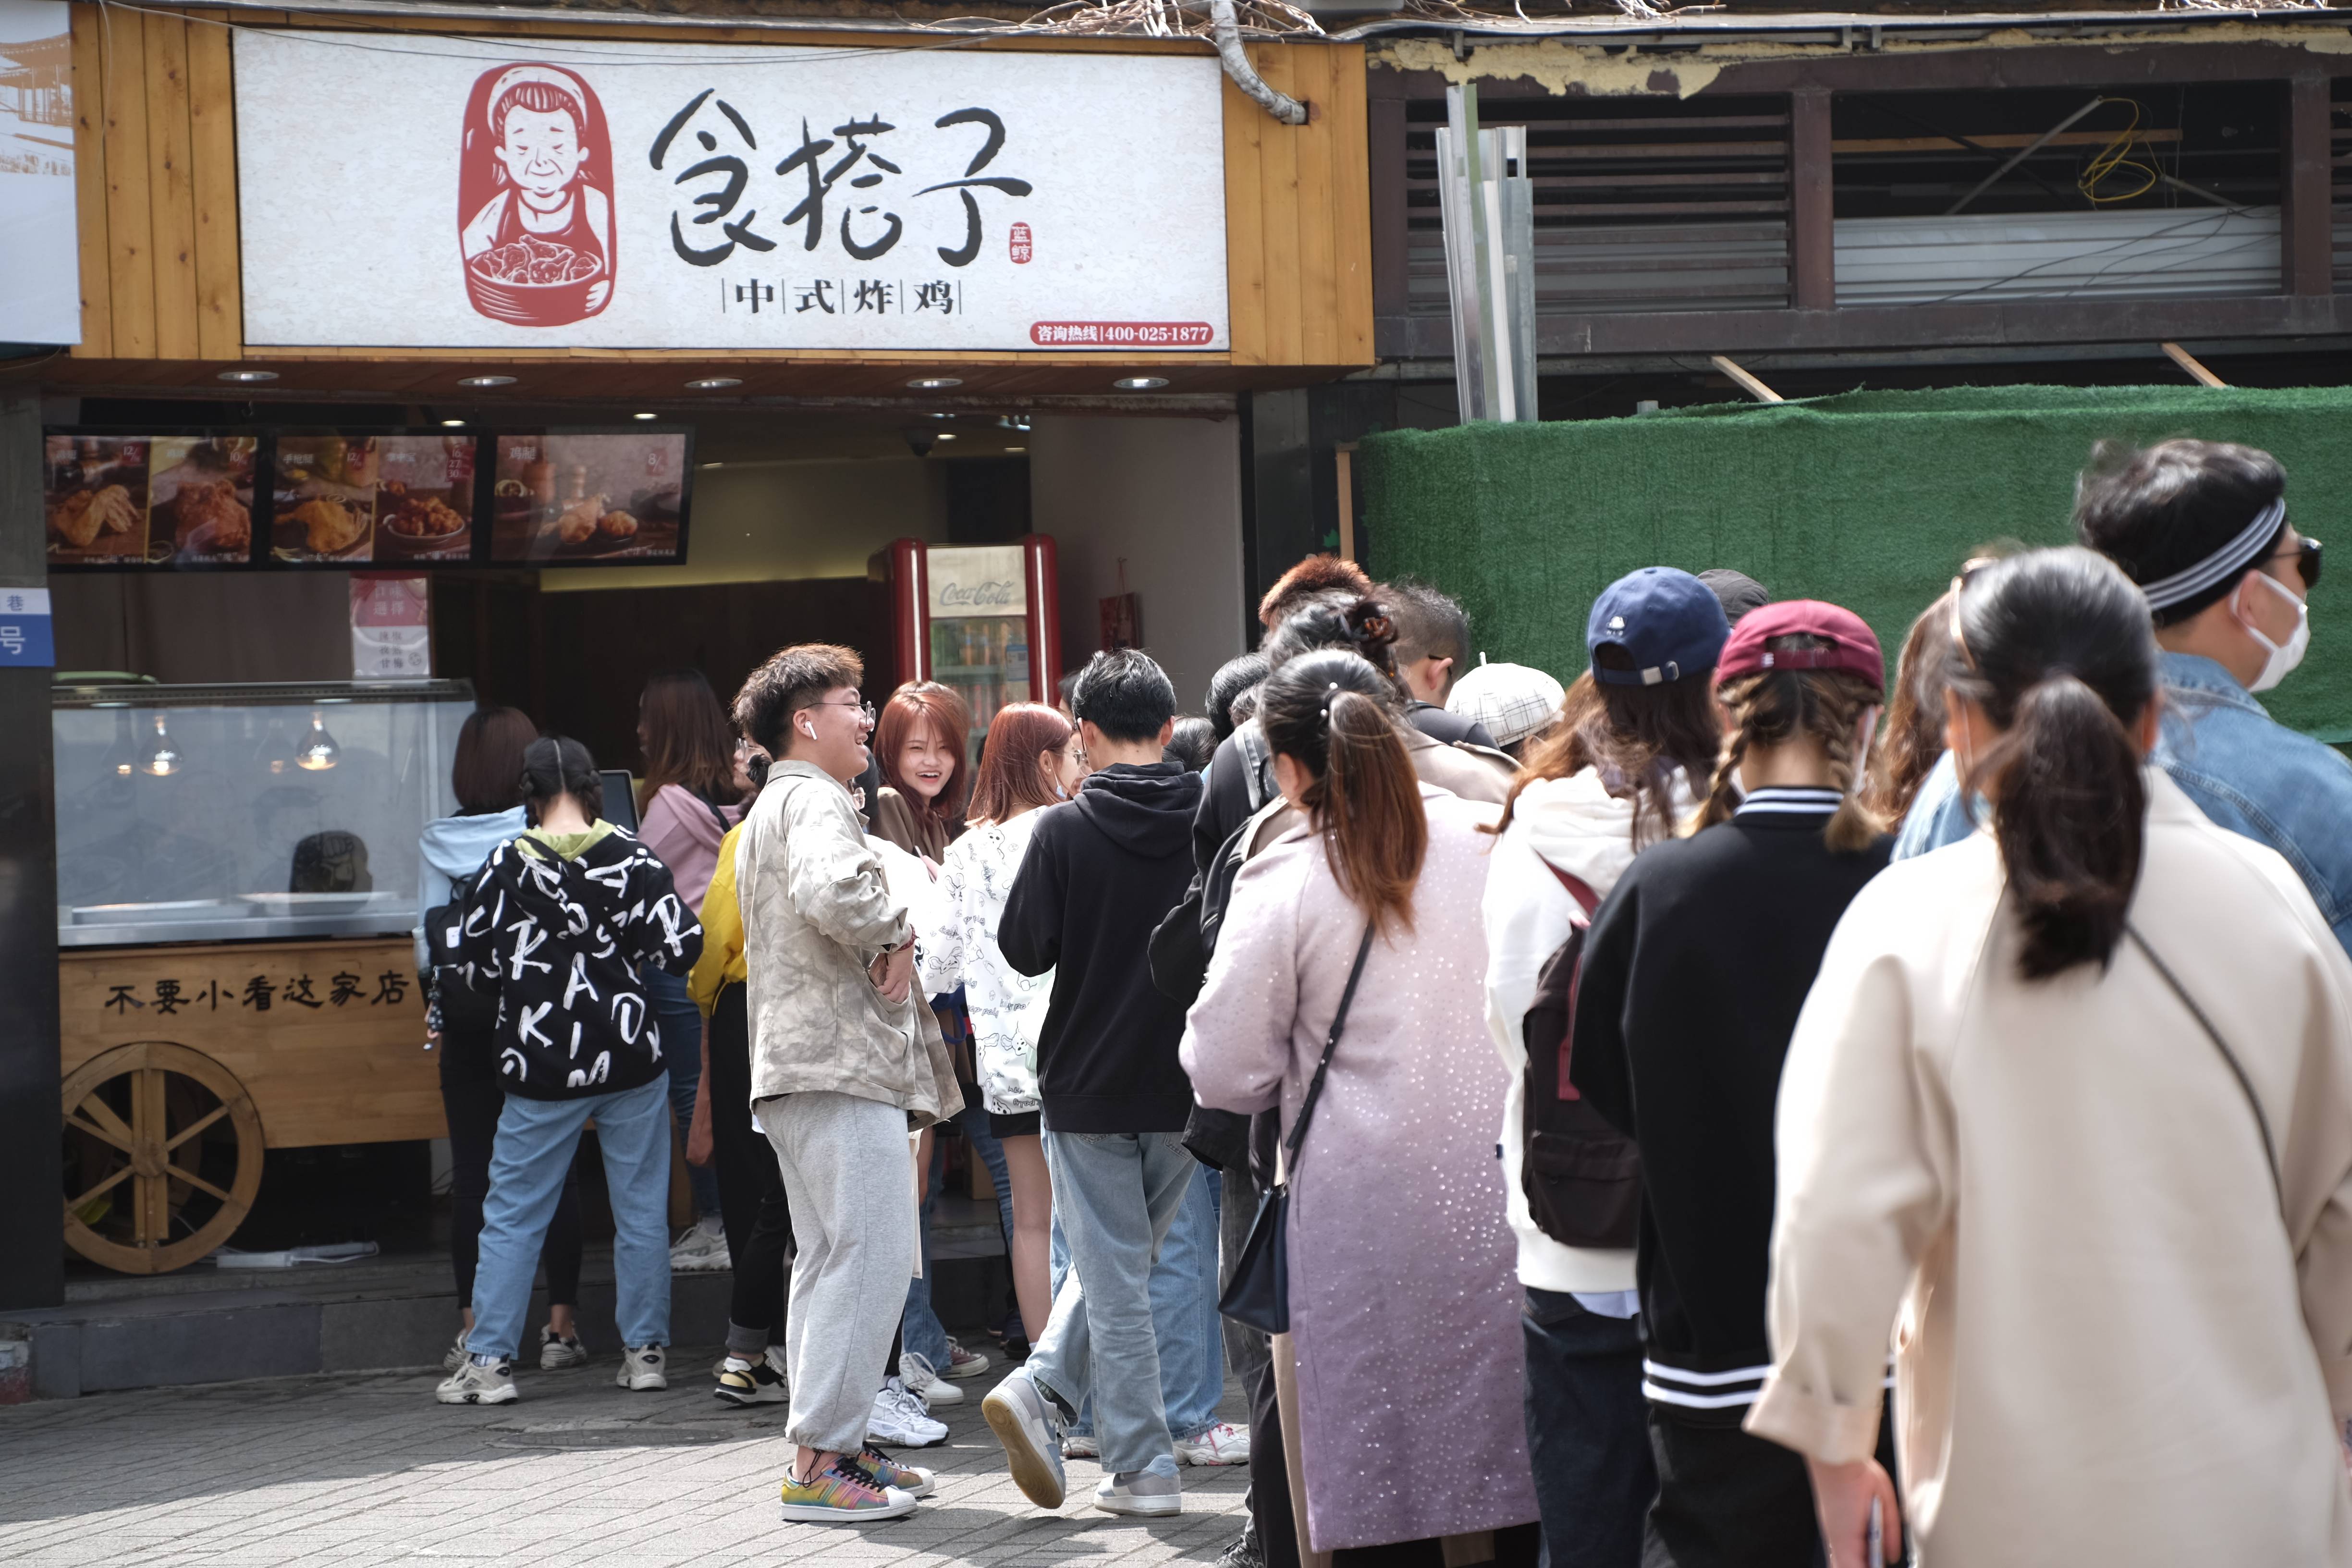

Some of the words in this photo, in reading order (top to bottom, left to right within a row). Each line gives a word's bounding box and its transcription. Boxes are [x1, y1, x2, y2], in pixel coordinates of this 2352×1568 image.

[649, 87, 1033, 267] 食搭子
[1011, 226, 1030, 261] 蓝鲸
[735, 279, 954, 315] 中式炸鸡
[1038, 325, 1098, 343] 咨询热线
[1105, 326, 1209, 341] 400-025-1877
[509, 446, 536, 461] 鸡腿
[7, 595, 24, 611] 巷
[939, 581, 1015, 606] Coca-Cola
[0, 626, 26, 655] 号
[105, 970, 409, 1015] 不要小看这家店
[563, 952, 599, 1010] A
[518, 1001, 553, 1048] K
